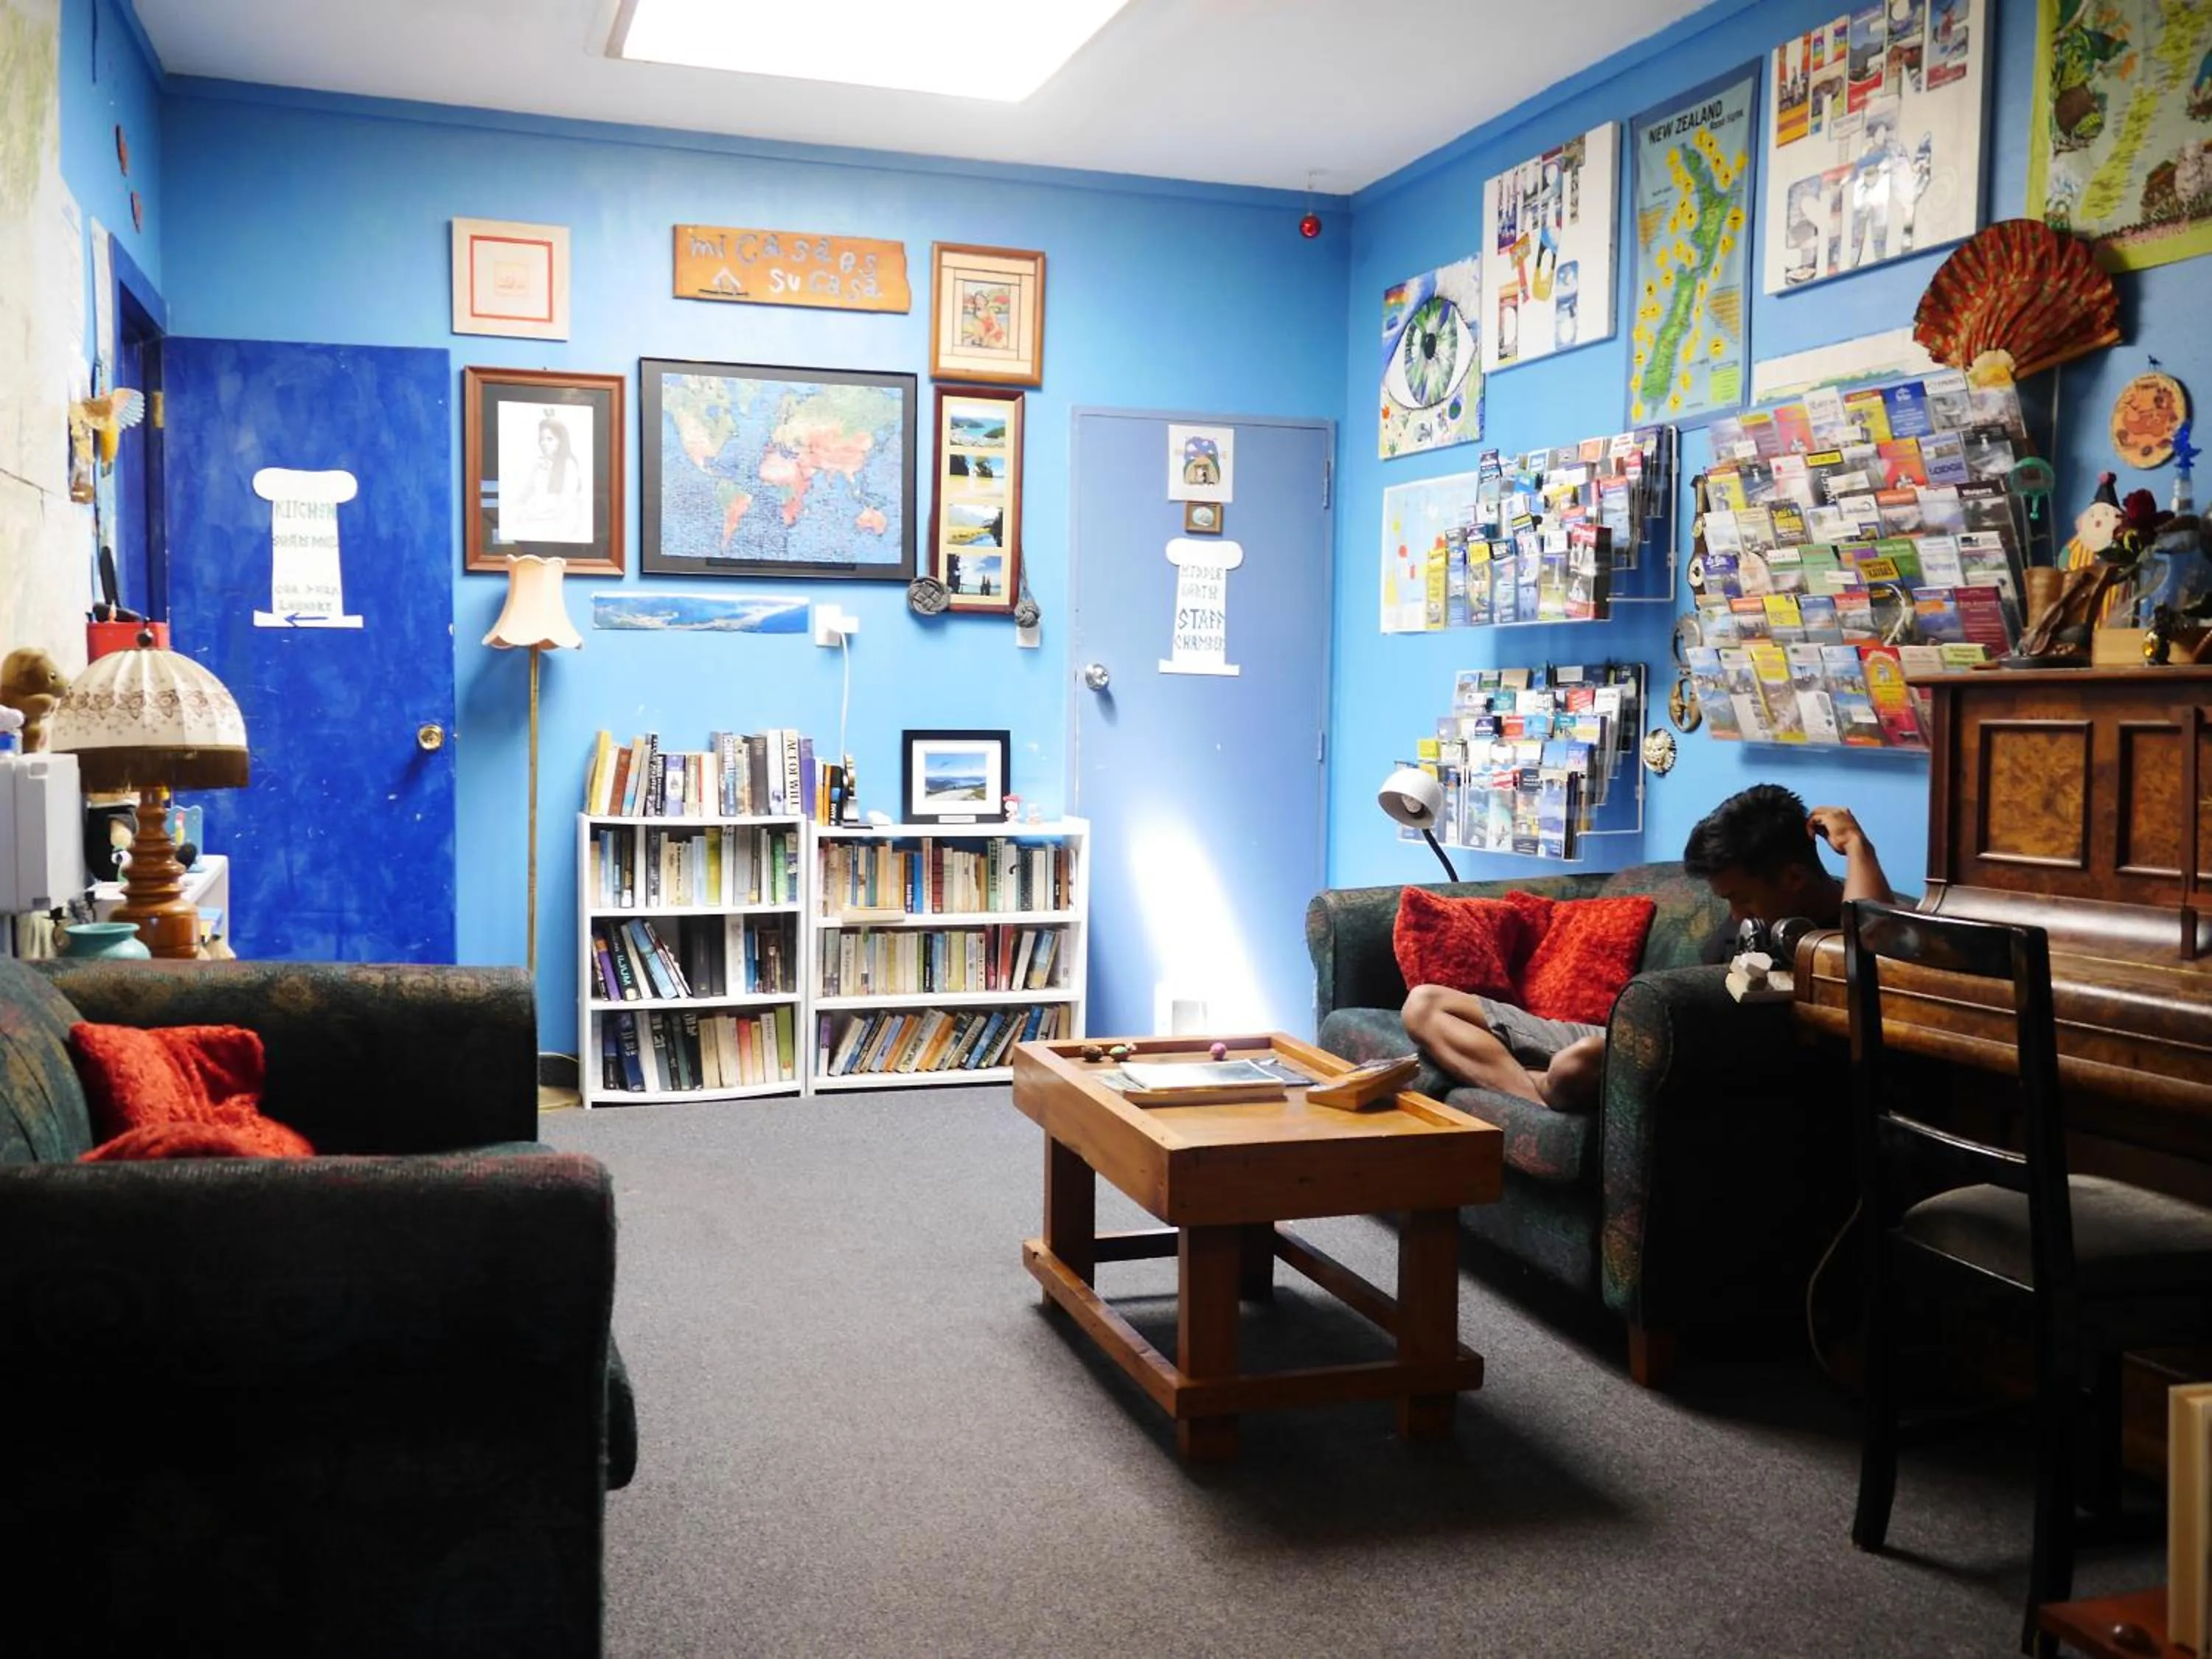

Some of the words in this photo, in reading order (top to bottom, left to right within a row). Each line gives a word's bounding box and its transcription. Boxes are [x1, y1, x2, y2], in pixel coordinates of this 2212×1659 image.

[1649, 120, 1674, 145] NEW
[1675, 100, 1723, 134] ZEALAND
[1498, 131, 1586, 256] WHAT
[1510, 224, 1561, 303] TO
[1498, 260, 1579, 365] DO
[275, 500, 336, 520] KITCHEN
[1178, 608, 1225, 630] STAFF
[788, 780, 800, 807] WILL
